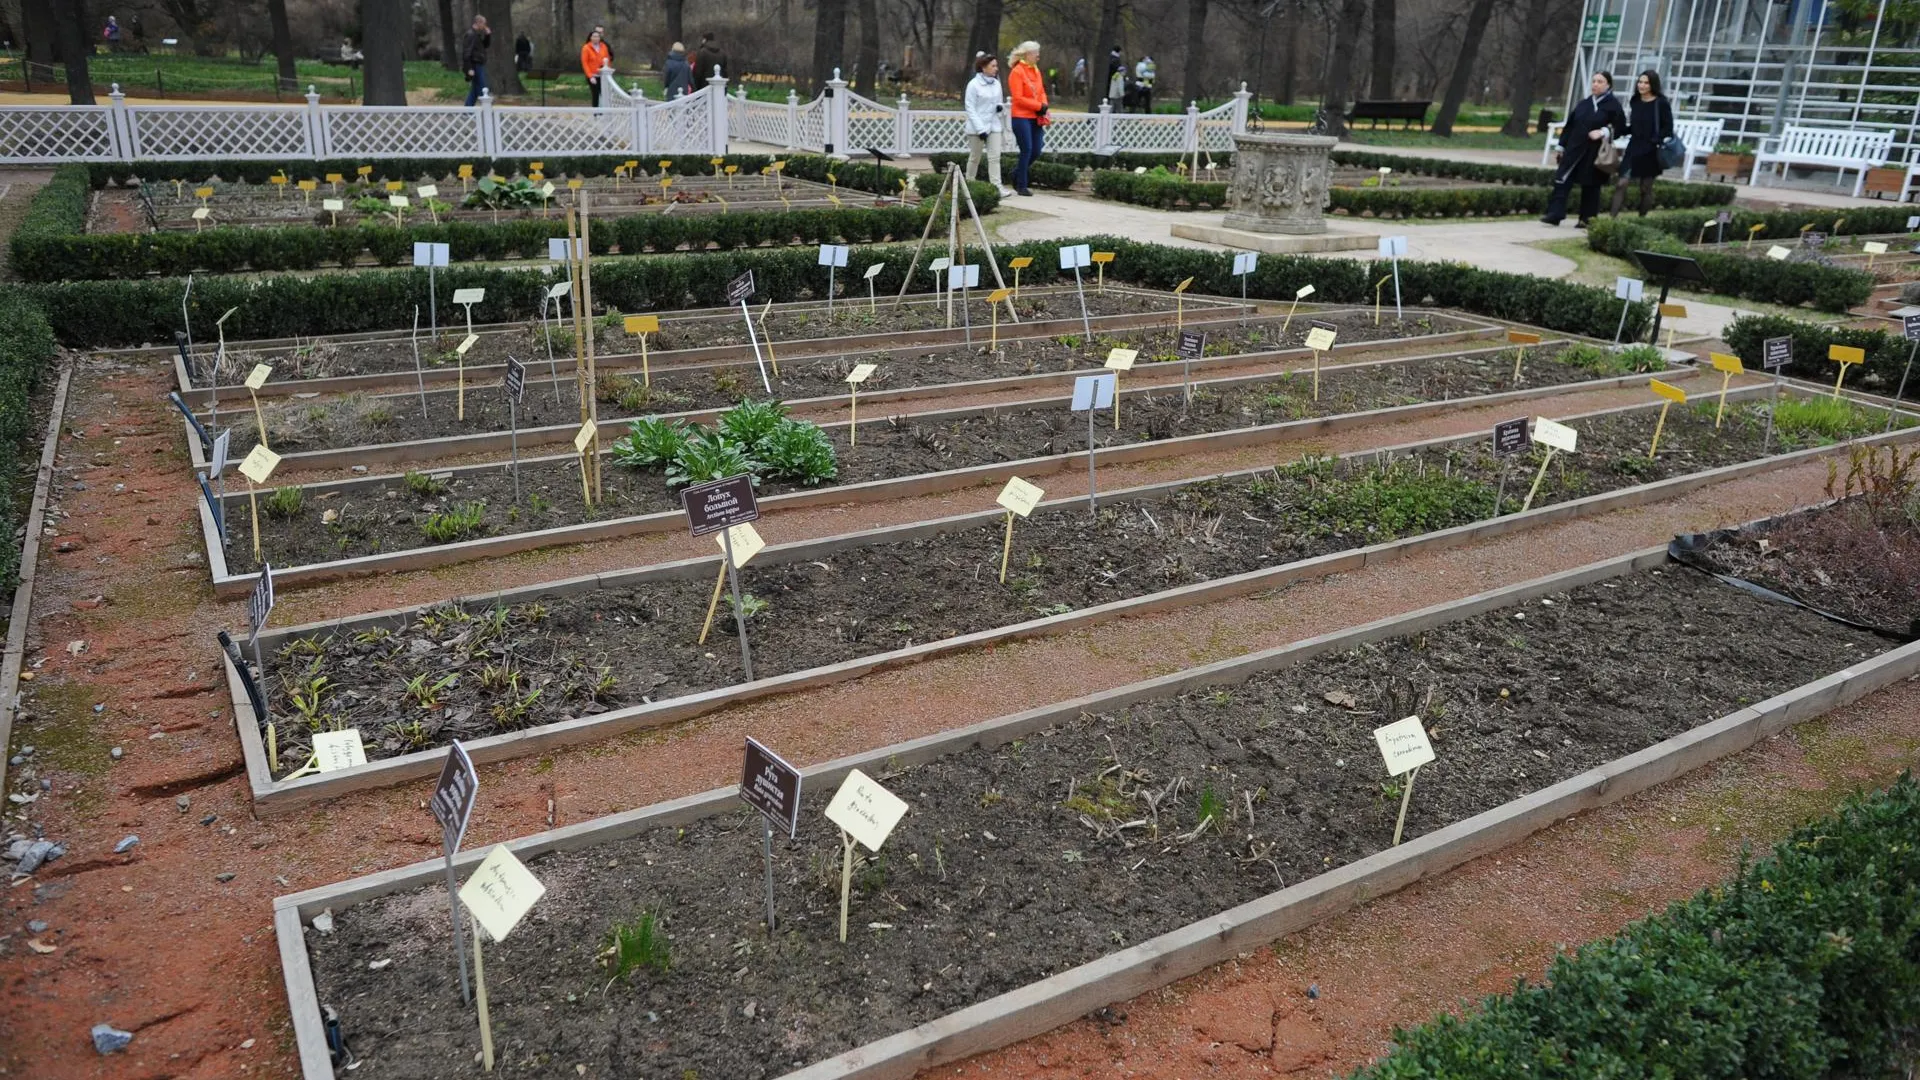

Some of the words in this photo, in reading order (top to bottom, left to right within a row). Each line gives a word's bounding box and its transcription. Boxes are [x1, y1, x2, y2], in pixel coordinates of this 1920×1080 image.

[703, 497, 738, 513] большой
[707, 491, 731, 503] Лопух
[764, 766, 778, 784] Рута
